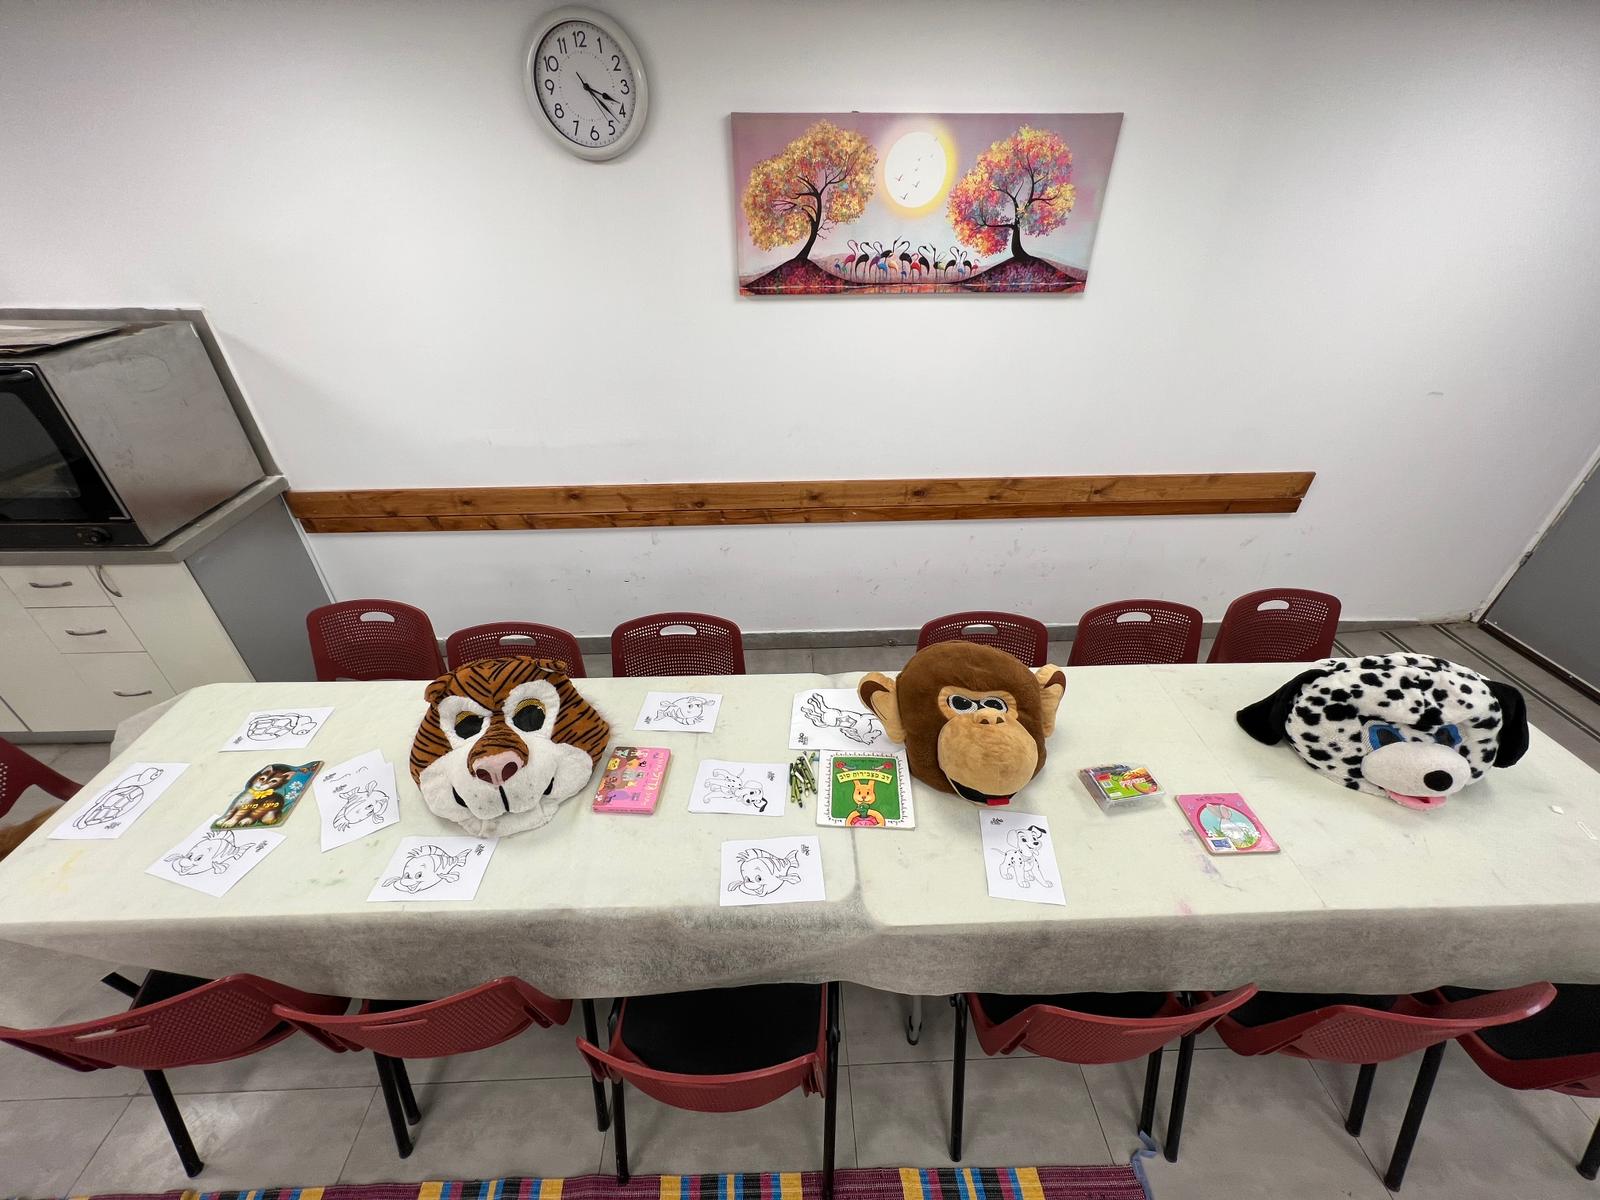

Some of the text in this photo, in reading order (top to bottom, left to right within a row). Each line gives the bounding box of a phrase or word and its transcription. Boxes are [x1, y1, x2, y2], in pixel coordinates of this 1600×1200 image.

[557, 37, 568, 54] 11
[572, 30, 588, 48] 12
[597, 37, 603, 54] 1
[543, 55, 559, 72] 10
[611, 55, 621, 71] 2
[544, 79, 555, 95] 9
[620, 79, 630, 95] 3
[554, 103, 565, 119] 8
[619, 102, 627, 118] 4
[573, 120, 579, 136] 7
[590, 126, 600, 141] 6
[608, 120, 616, 136] 5
